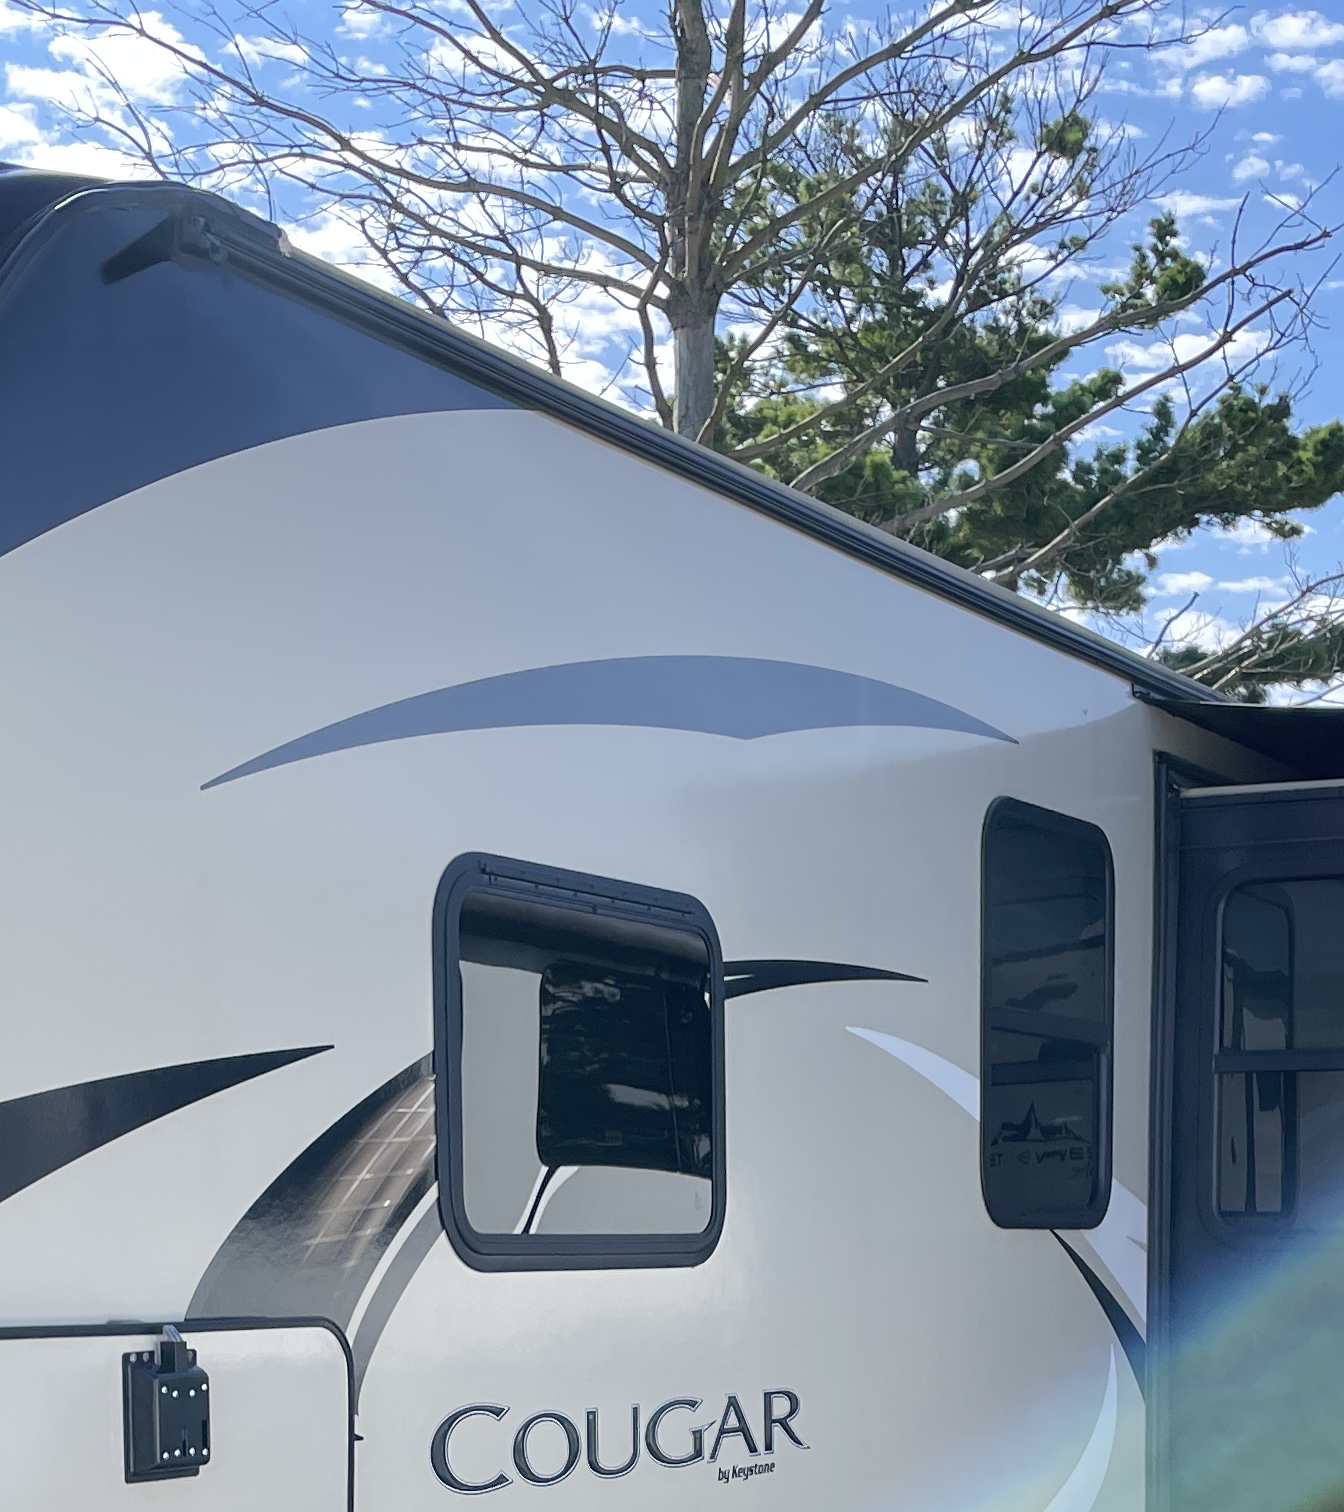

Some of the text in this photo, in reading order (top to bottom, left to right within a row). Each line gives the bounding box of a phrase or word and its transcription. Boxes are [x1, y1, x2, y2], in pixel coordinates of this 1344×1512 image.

[429, 1387, 811, 1496] COUGAR
[717, 1462, 776, 1484] by Keystone
